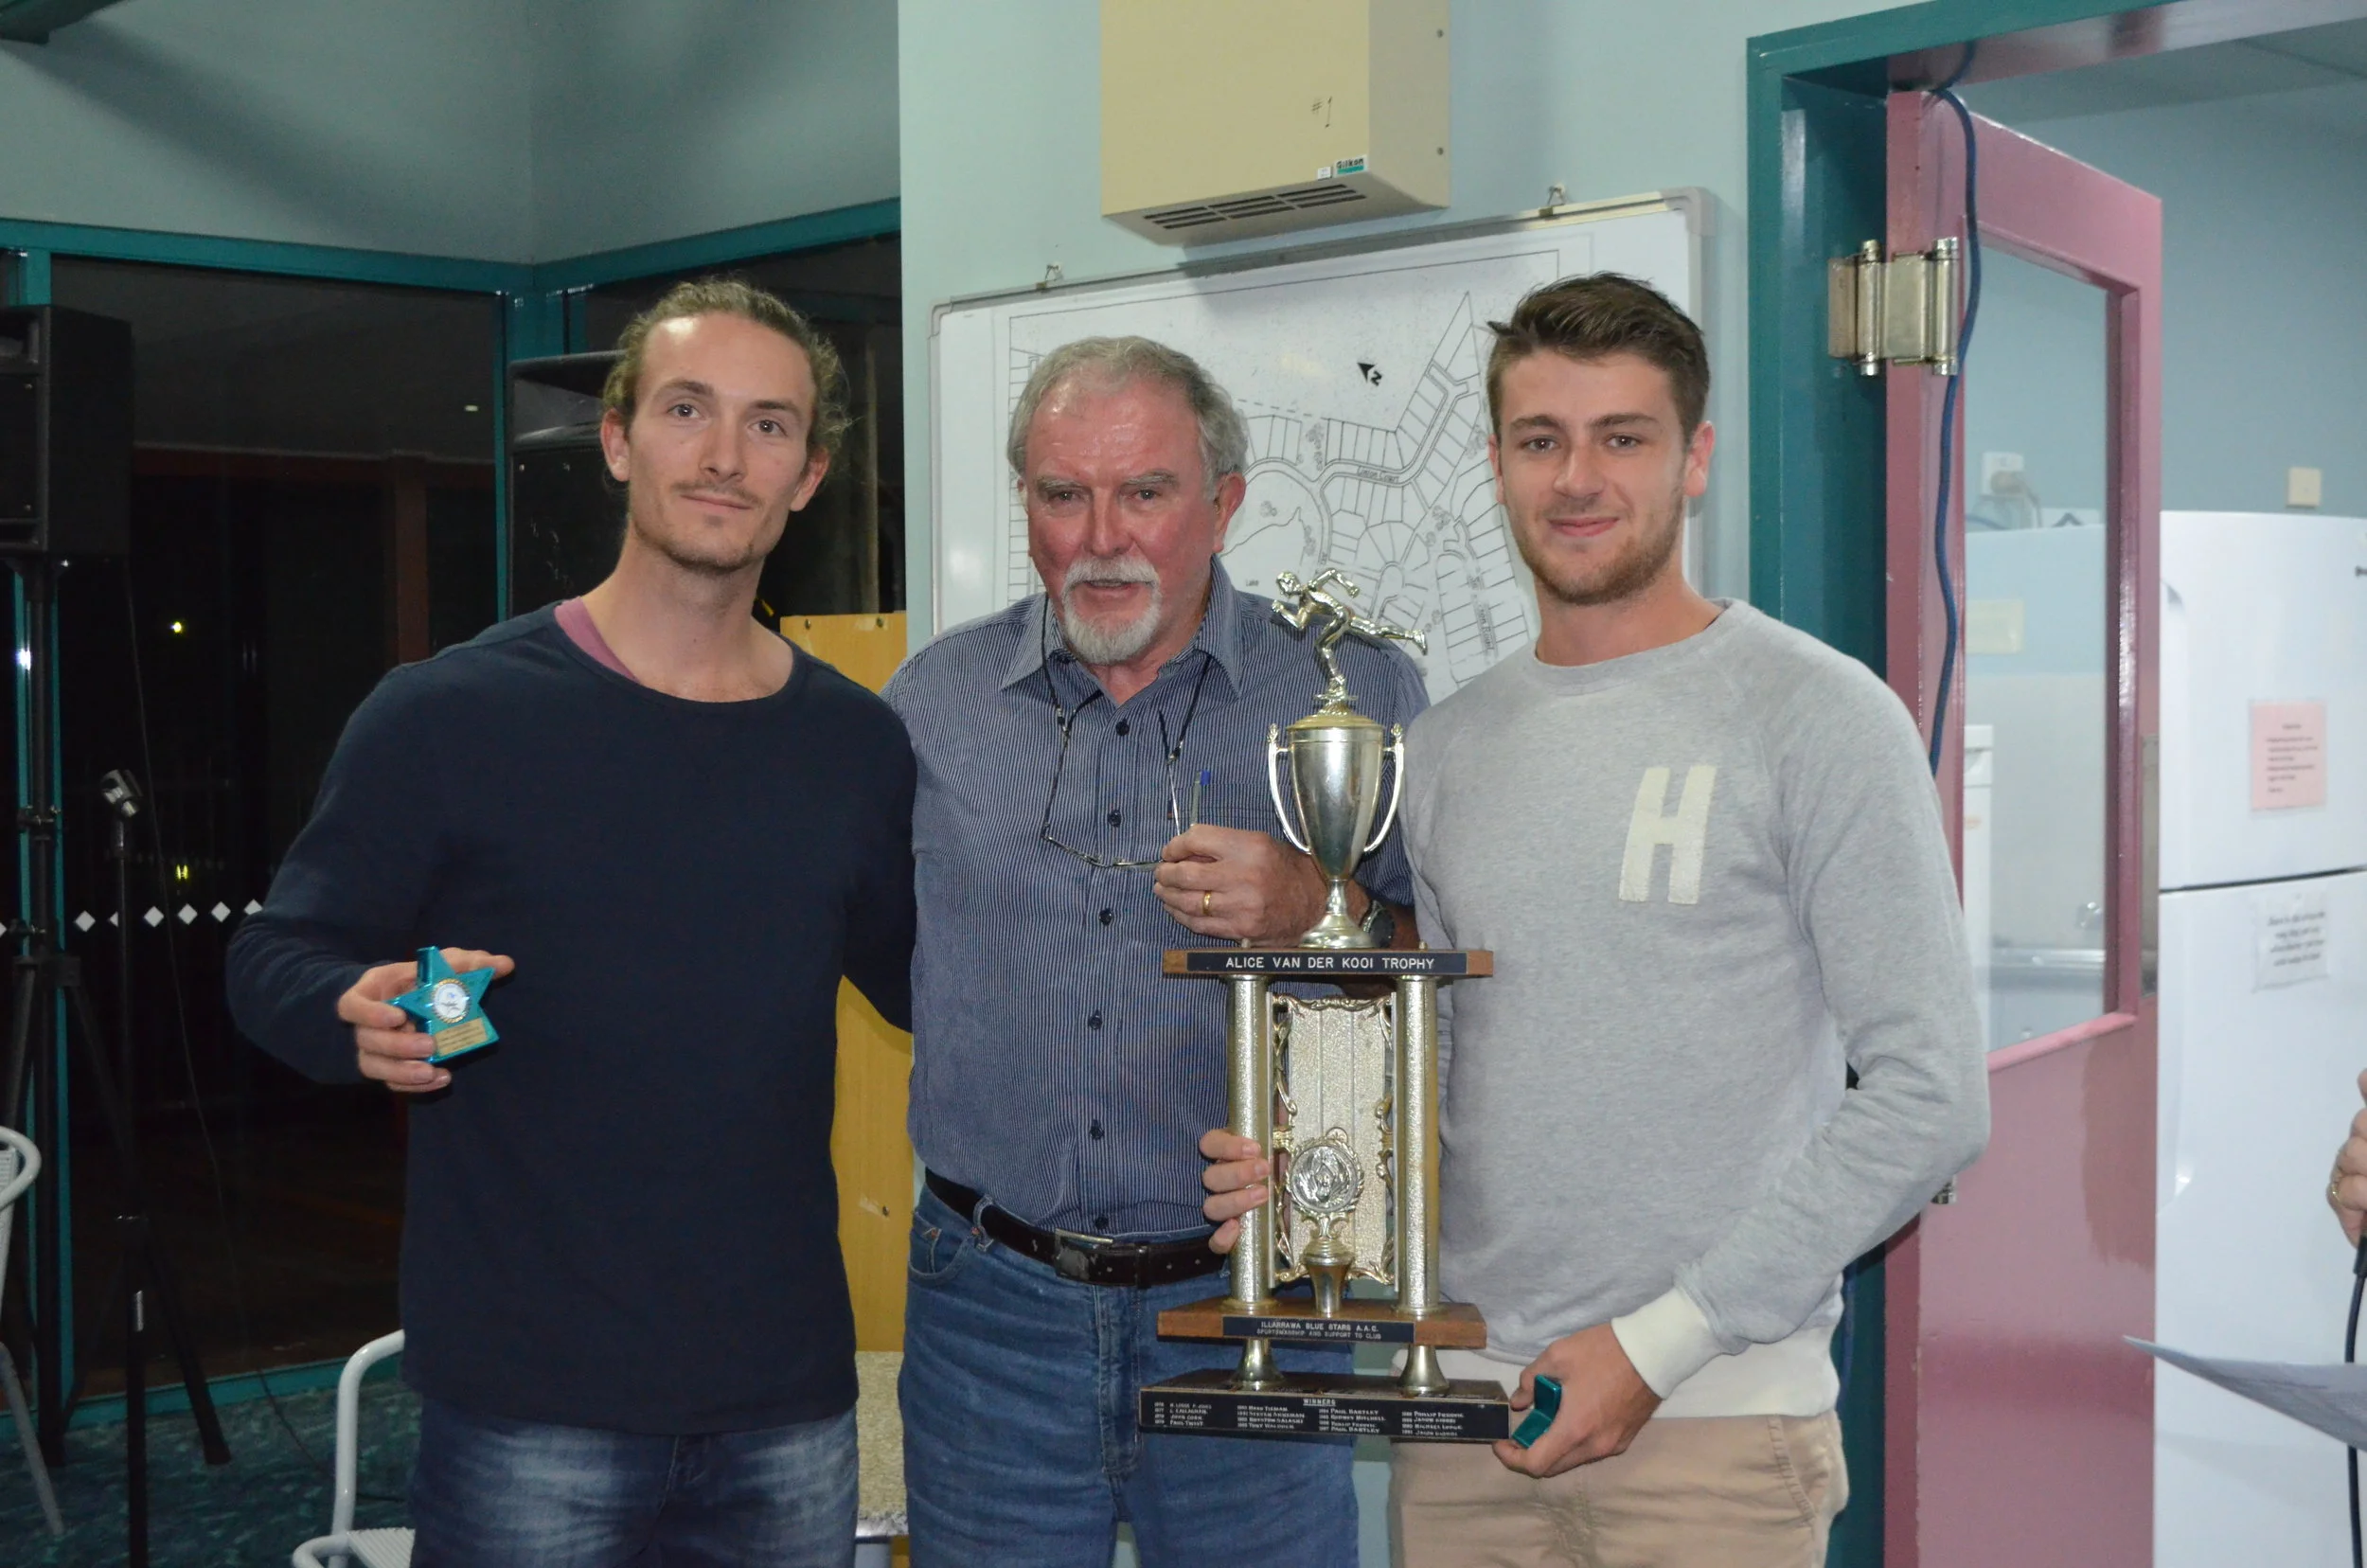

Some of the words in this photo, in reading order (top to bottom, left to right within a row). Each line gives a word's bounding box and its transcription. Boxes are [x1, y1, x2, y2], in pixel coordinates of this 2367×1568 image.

[1619, 765, 1717, 905] H
[1225, 956, 1265, 969] ALICE
[1272, 957, 1301, 969] VAN
[1308, 957, 1334, 969] DER
[1342, 957, 1374, 969] KOOI
[1381, 957, 1434, 970] TROPHY
